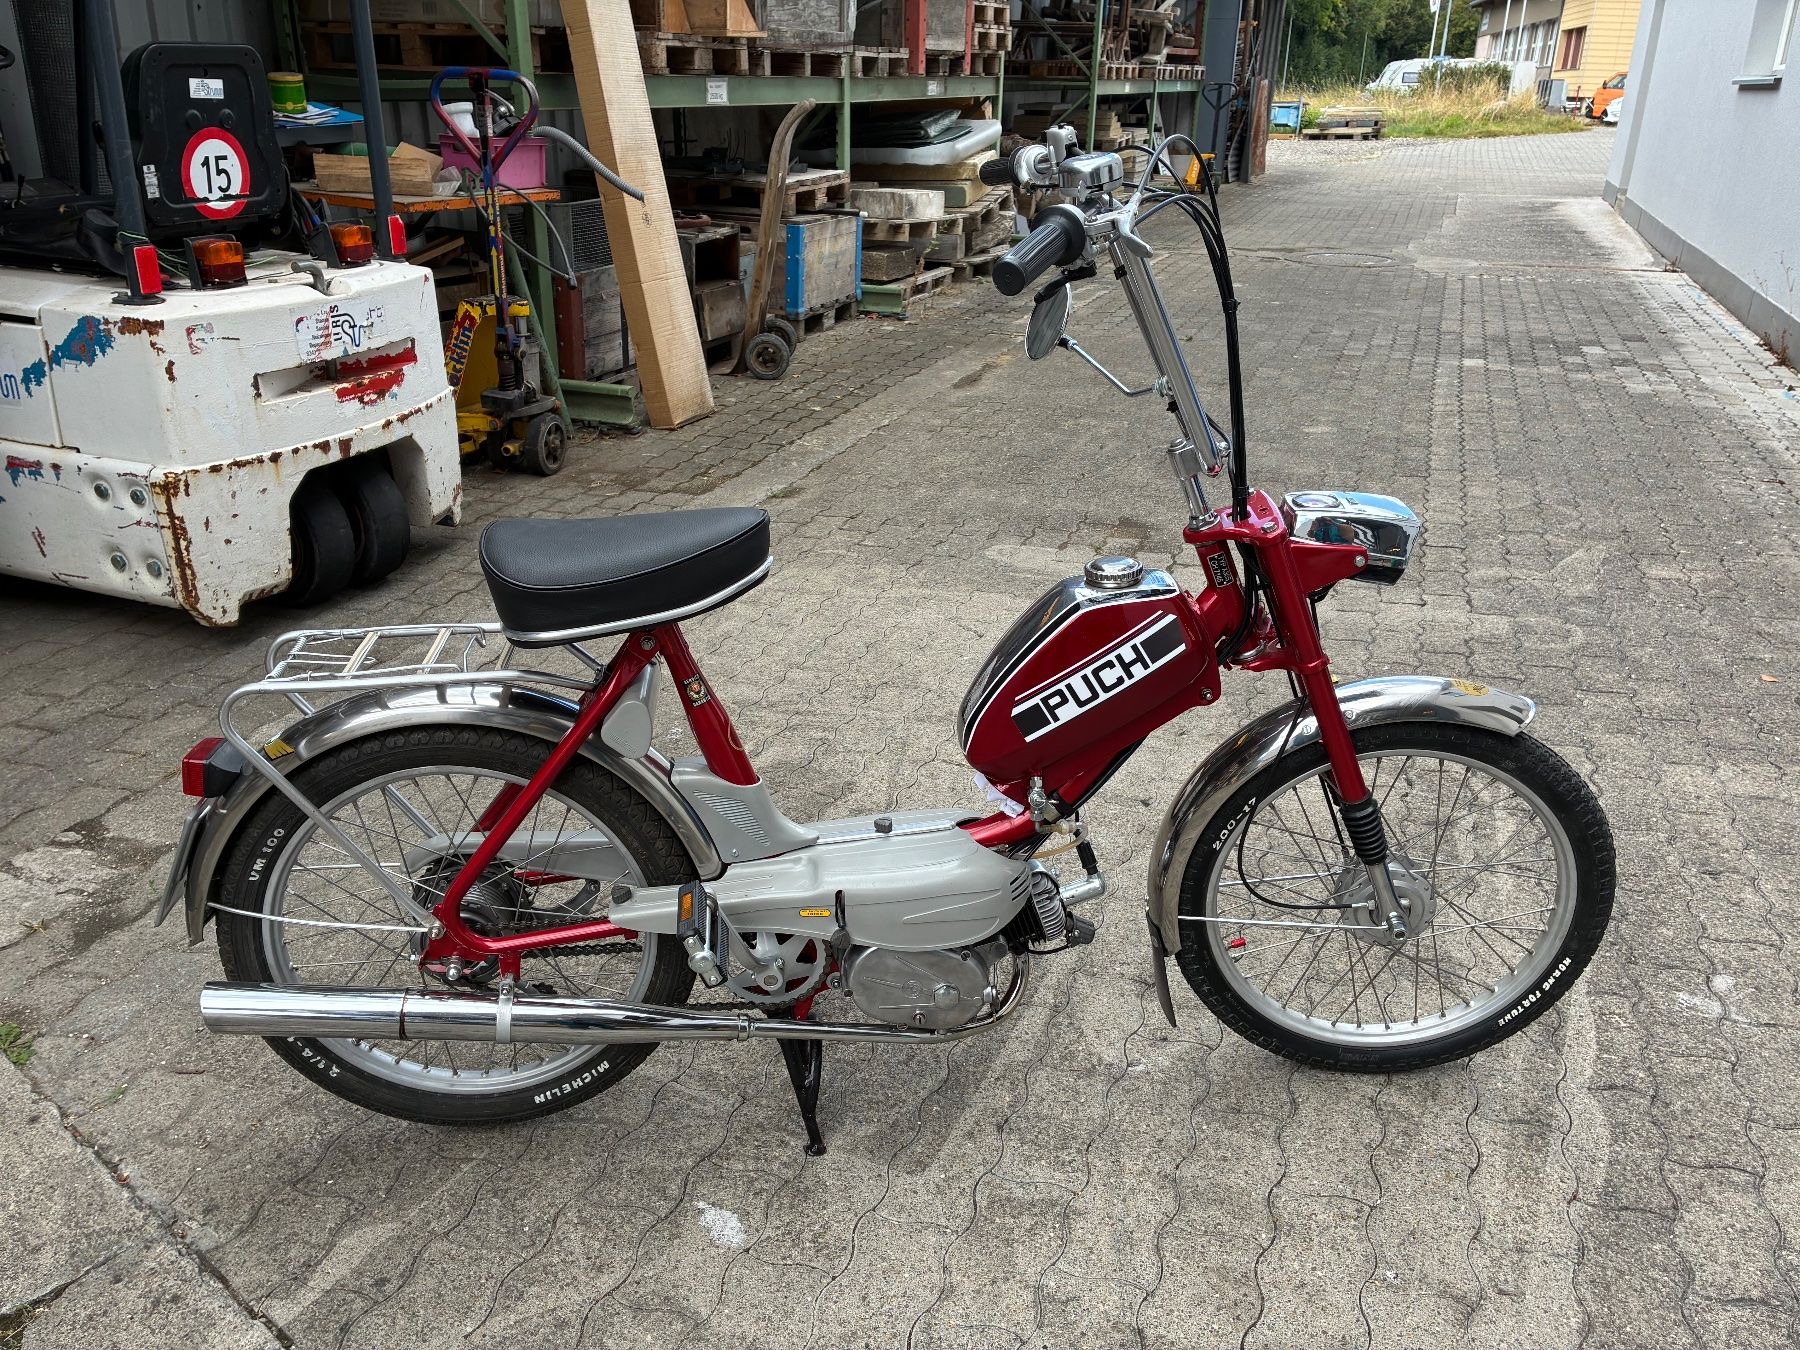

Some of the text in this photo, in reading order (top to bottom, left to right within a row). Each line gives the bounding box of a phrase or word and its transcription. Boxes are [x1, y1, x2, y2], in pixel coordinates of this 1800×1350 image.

[200, 154, 232, 194] 15
[1039, 642, 1151, 724] PUCH
[248, 828, 285, 881] VM 100
[1497, 990, 1542, 1027] FORTUNE
[533, 1060, 610, 1104] MICHELIN
